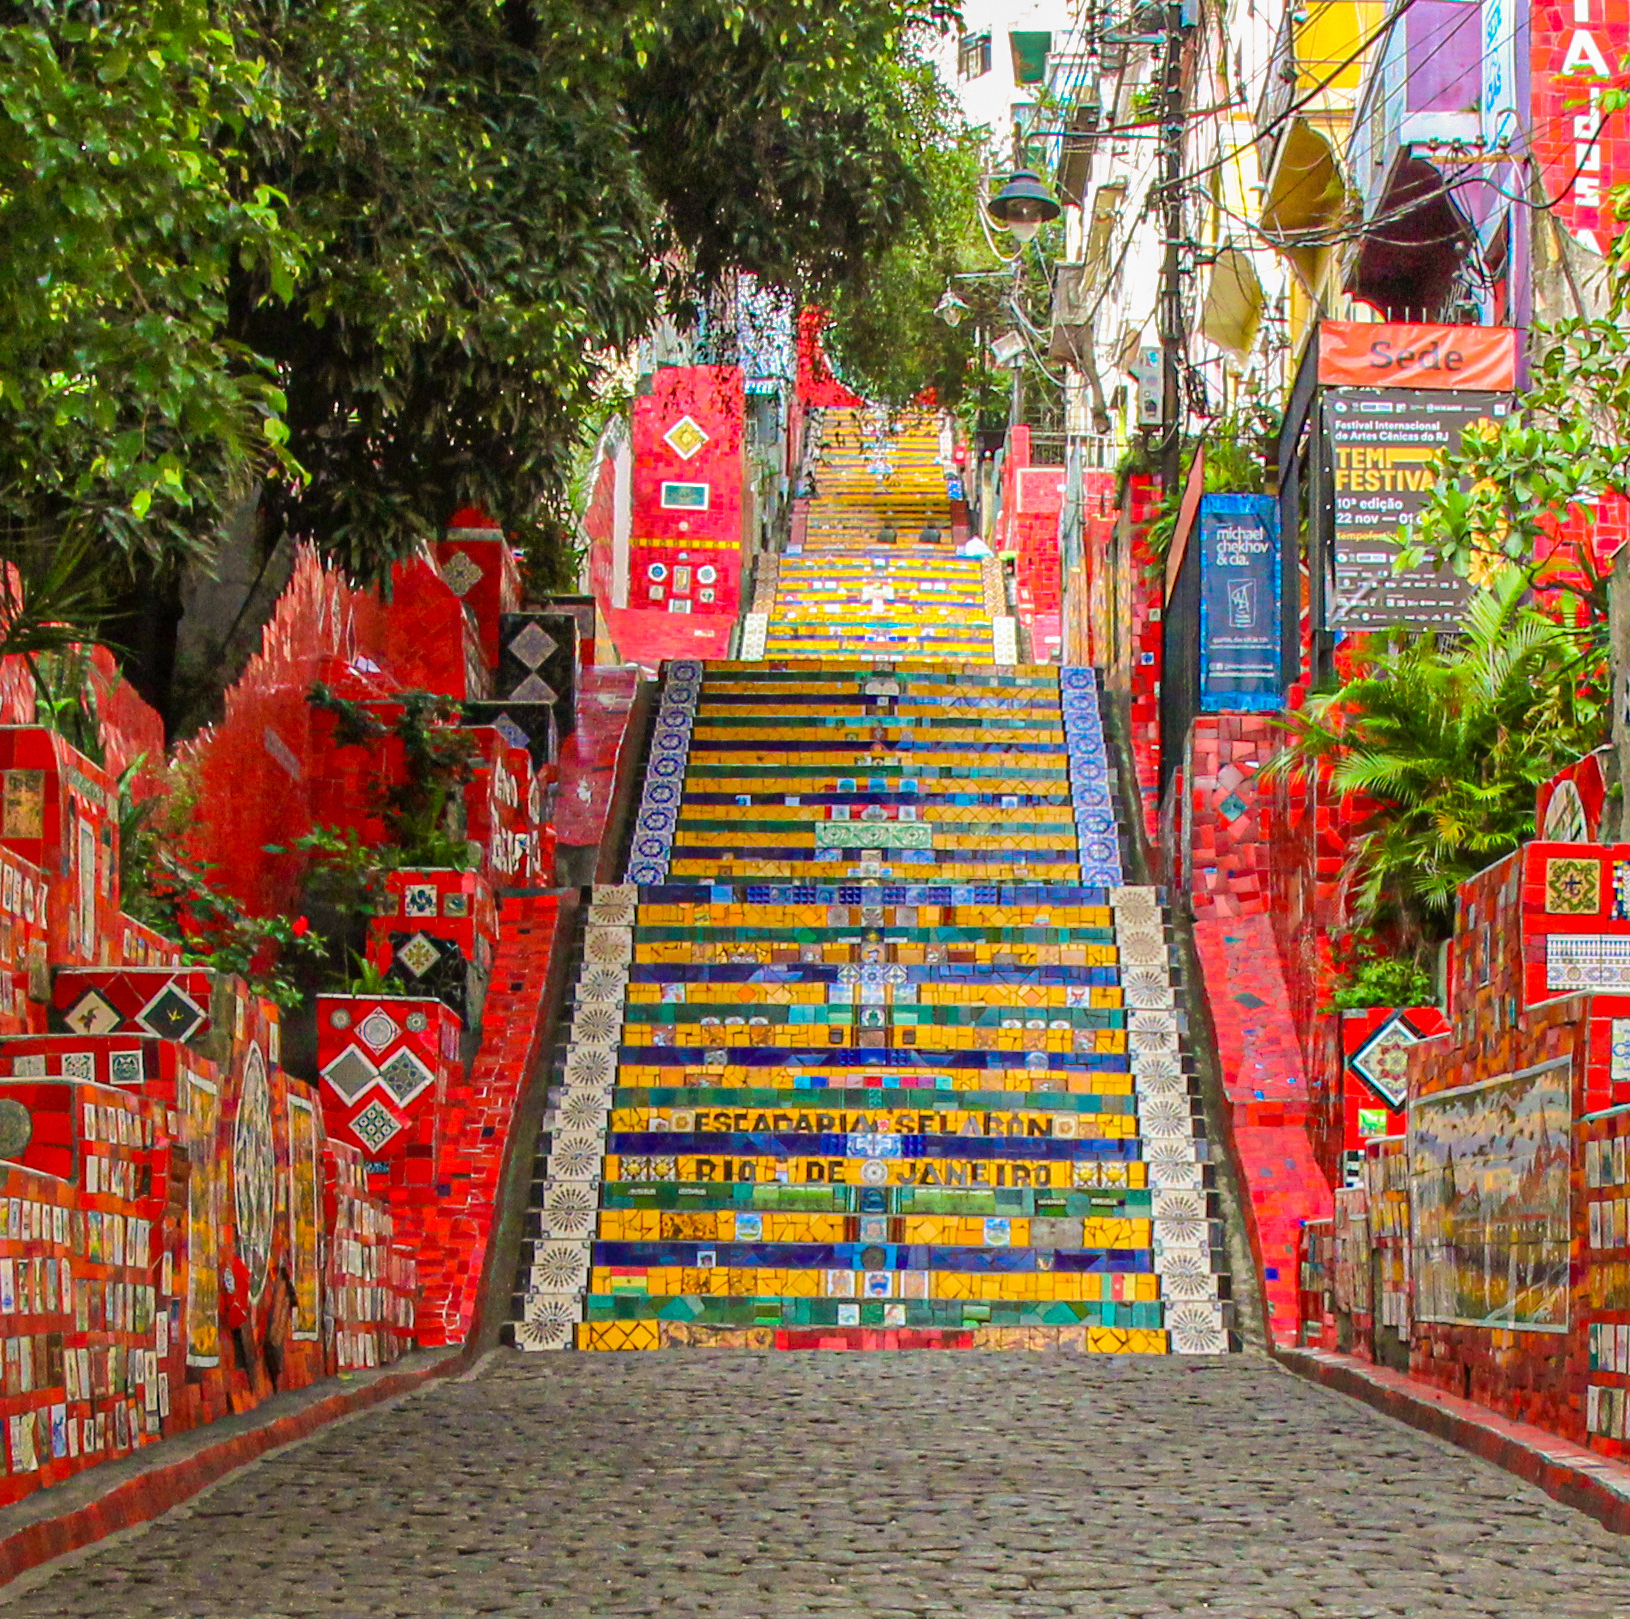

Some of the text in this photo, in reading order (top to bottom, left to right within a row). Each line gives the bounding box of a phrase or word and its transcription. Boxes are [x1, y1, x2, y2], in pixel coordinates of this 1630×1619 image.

[1370, 340, 1464, 373] Sede
[1335, 420, 1441, 431] Festival Internacional
[1335, 431, 1449, 442] de Artes Cênicas do RJ
[1359, 497, 1403, 512] edição
[1336, 513, 1352, 524] 22
[1355, 515, 1379, 524] nov
[1399, 513, 1414, 524] 01
[1216, 527, 1264, 541] michael
[1216, 540, 1269, 554] chekhov
[1216, 553, 1228, 566] &
[695, 1111, 879, 1133] ESCADARIA
[696, 1158, 1051, 1187] RIO DE JANEIRO
